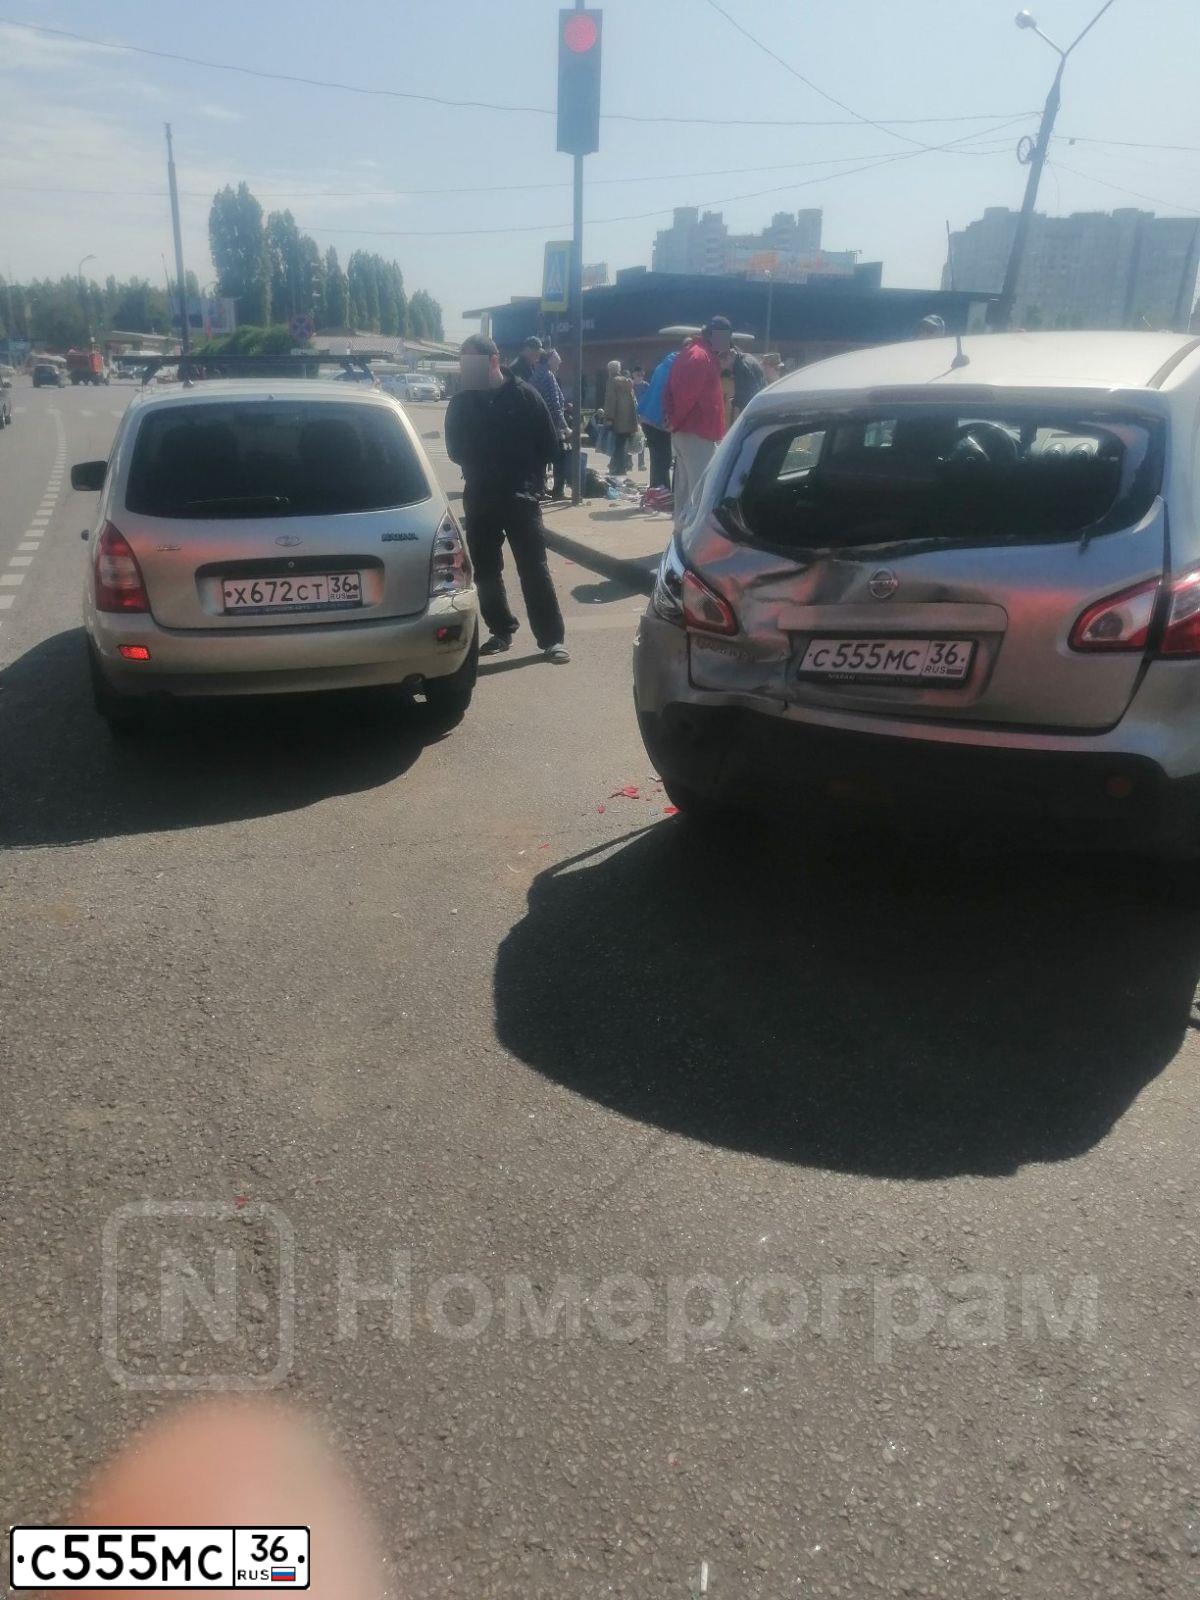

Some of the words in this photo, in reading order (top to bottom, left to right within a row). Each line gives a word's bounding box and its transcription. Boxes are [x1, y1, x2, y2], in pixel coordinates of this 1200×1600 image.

[234, 580, 323, 604] Х672СТ
[330, 576, 351, 593] 36
[813, 643, 920, 671] С555МС
[930, 643, 958, 664] 36
[923, 665, 946, 674] RUS
